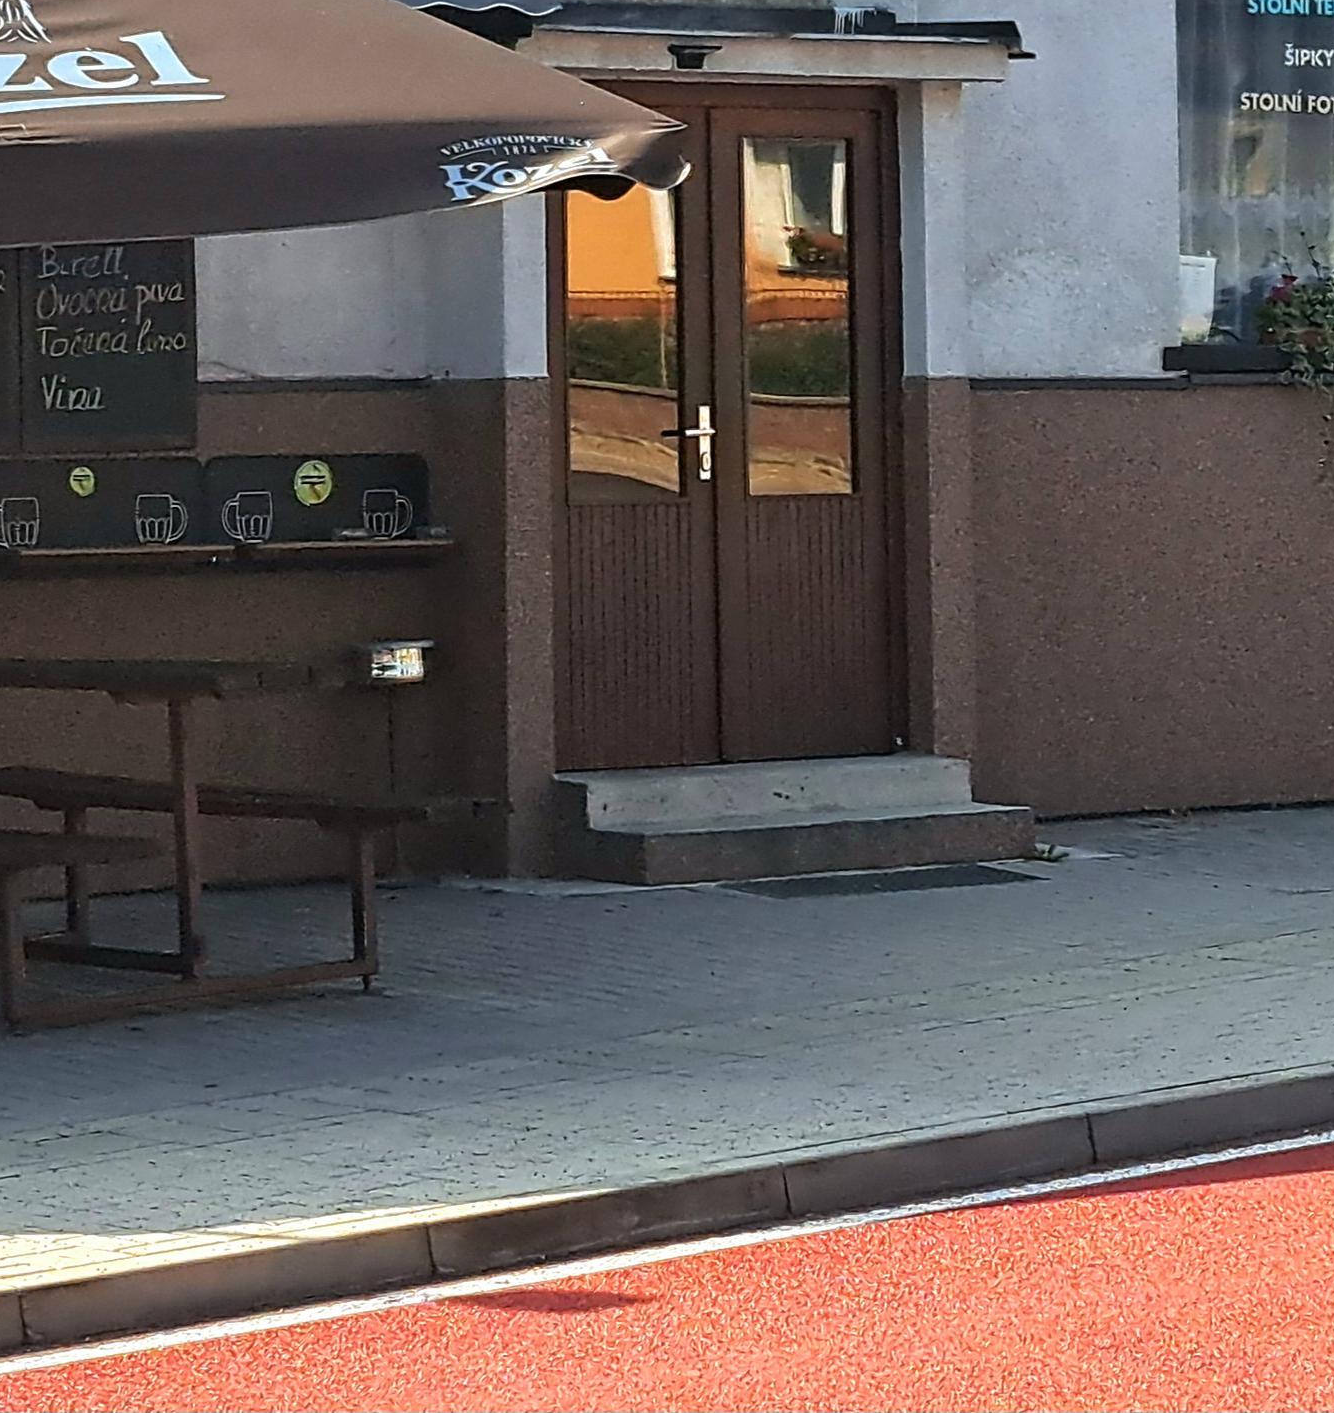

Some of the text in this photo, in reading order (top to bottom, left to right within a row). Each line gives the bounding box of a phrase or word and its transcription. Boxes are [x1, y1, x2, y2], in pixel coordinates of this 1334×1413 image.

[1284, 42, 1334, 67] ŠIPKY
[1240, 88, 1302, 113] STOLNÍ
[439, 148, 617, 201] Kozel
